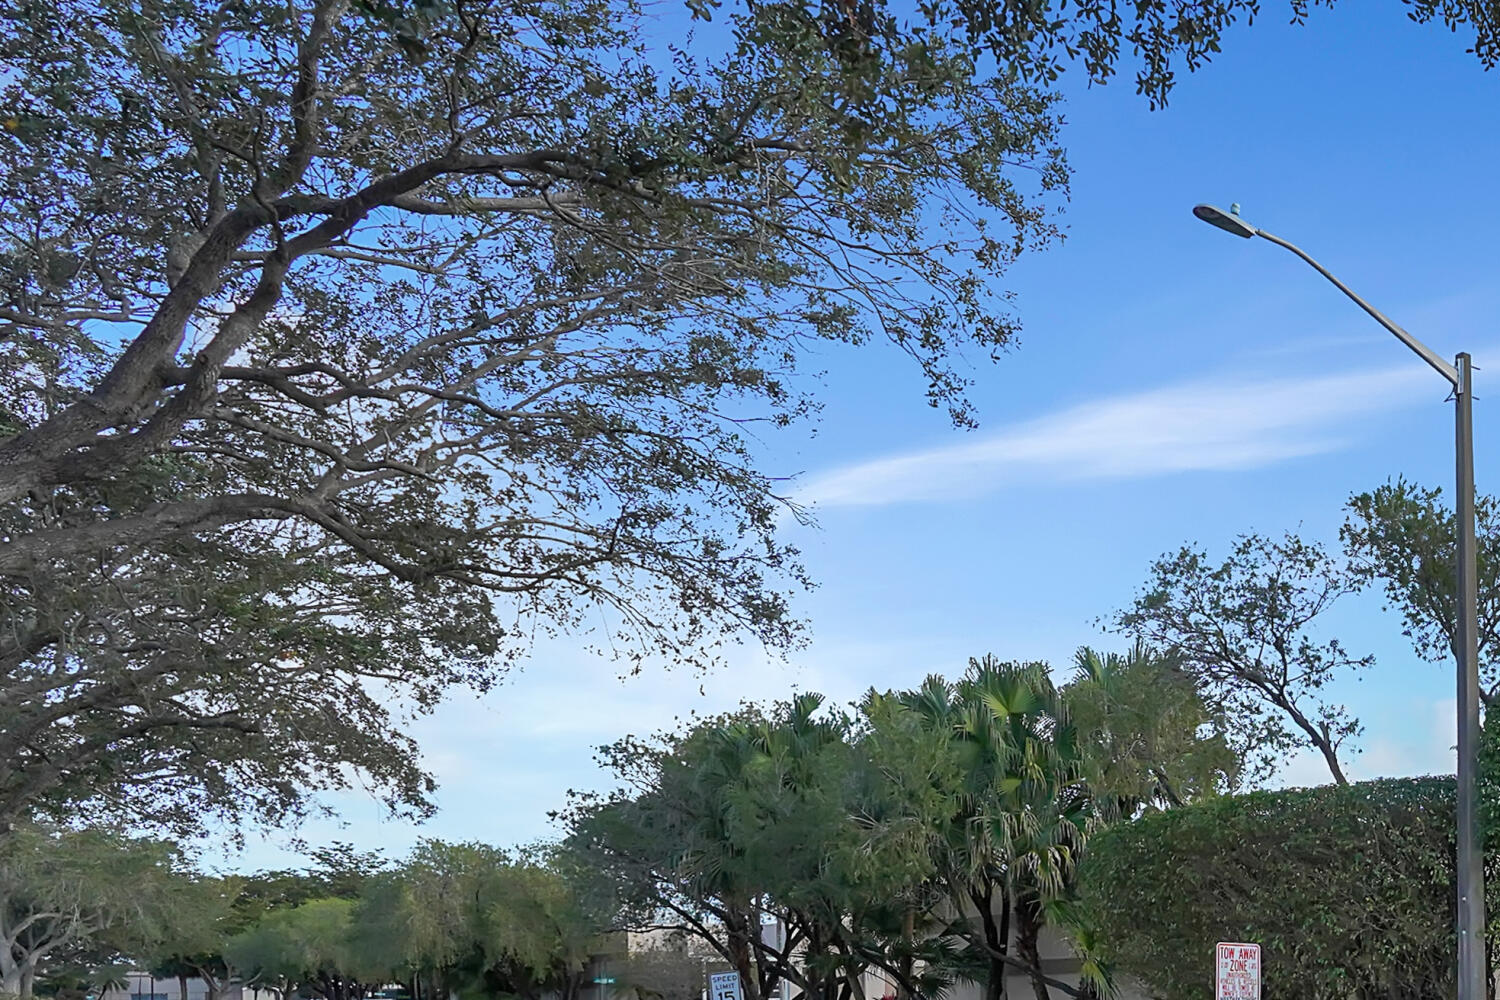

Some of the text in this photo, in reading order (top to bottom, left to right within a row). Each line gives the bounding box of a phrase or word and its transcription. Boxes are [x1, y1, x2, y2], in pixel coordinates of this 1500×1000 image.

[1220, 947, 1257, 960] TOW AWAY
[1229, 959, 1248, 972] ZONE
[712, 975, 737, 983] SPEED
[715, 983, 735, 991] LIMIT
